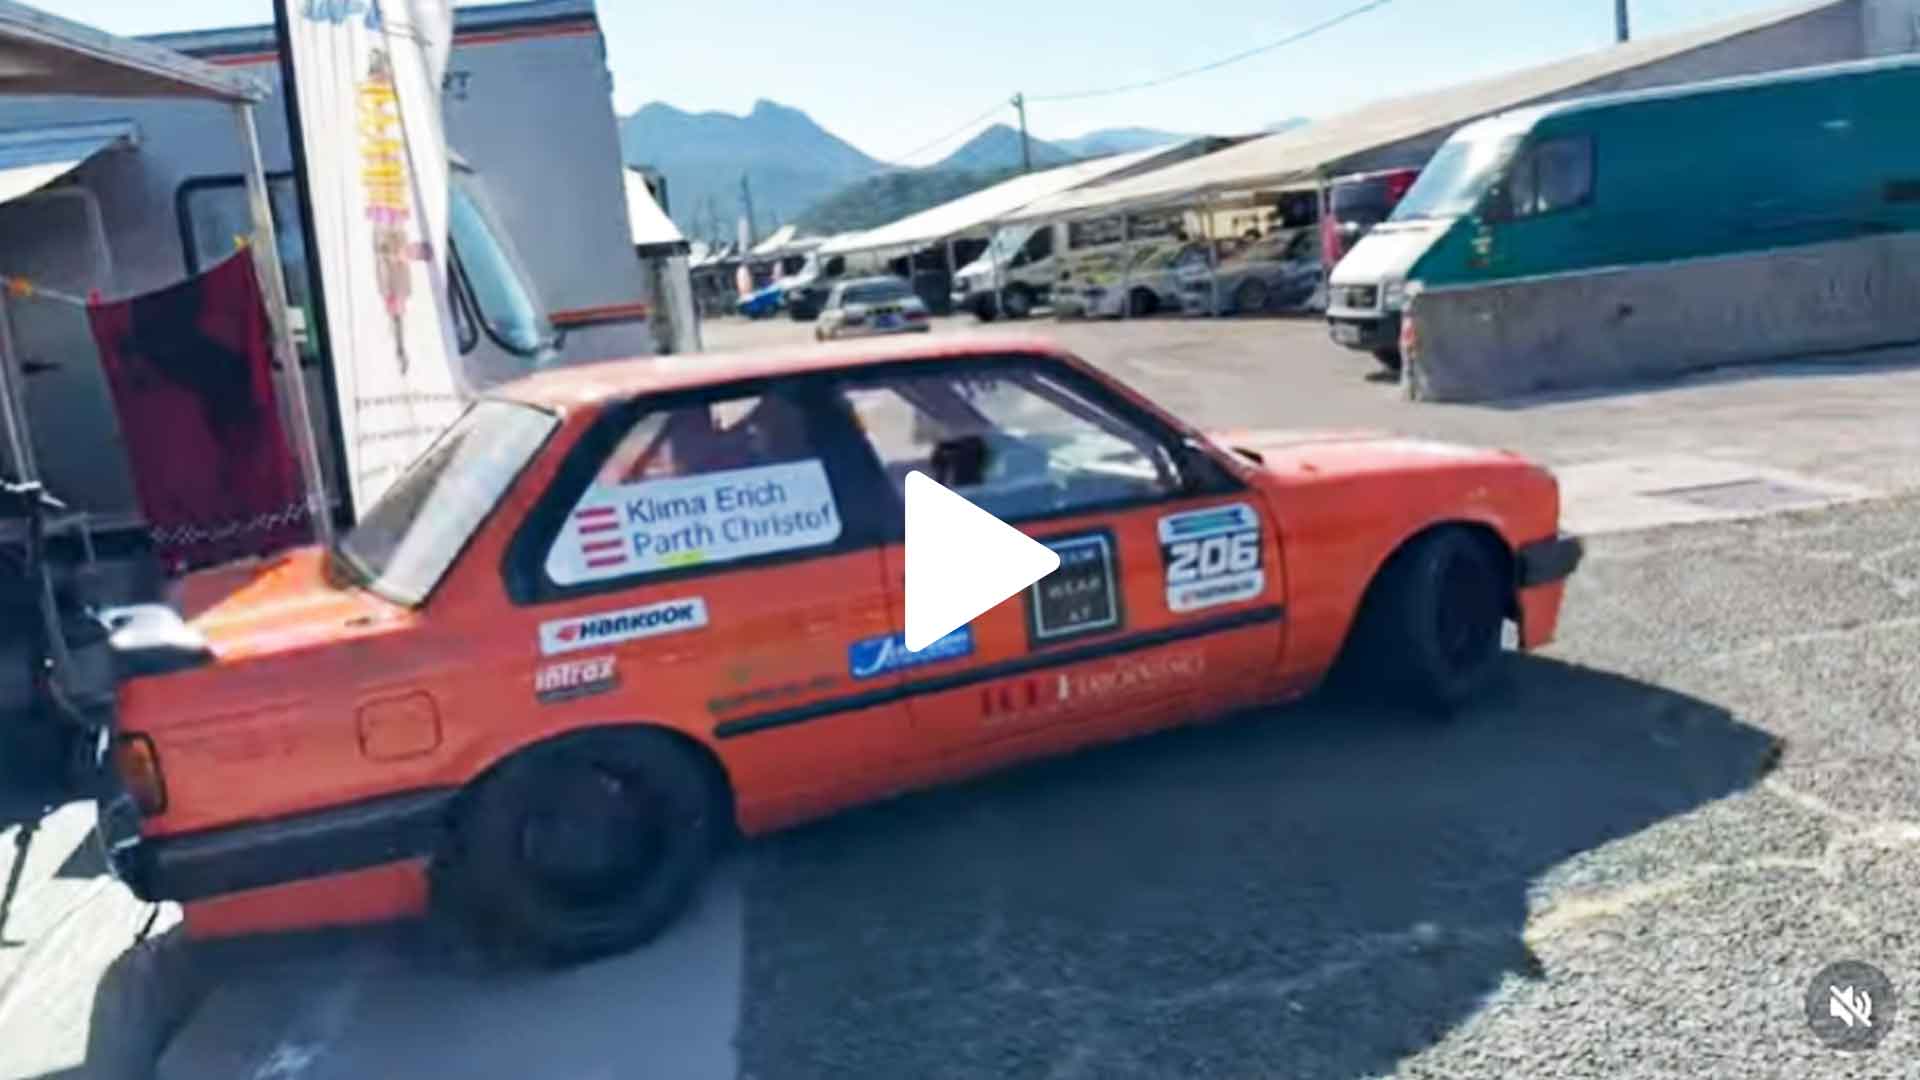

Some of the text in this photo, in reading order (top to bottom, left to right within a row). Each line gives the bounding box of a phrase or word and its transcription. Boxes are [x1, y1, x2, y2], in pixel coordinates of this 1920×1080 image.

[626, 480, 786, 523] Klima Erich
[632, 504, 831, 556] Parth Christof
[1167, 532, 1259, 581] 206
